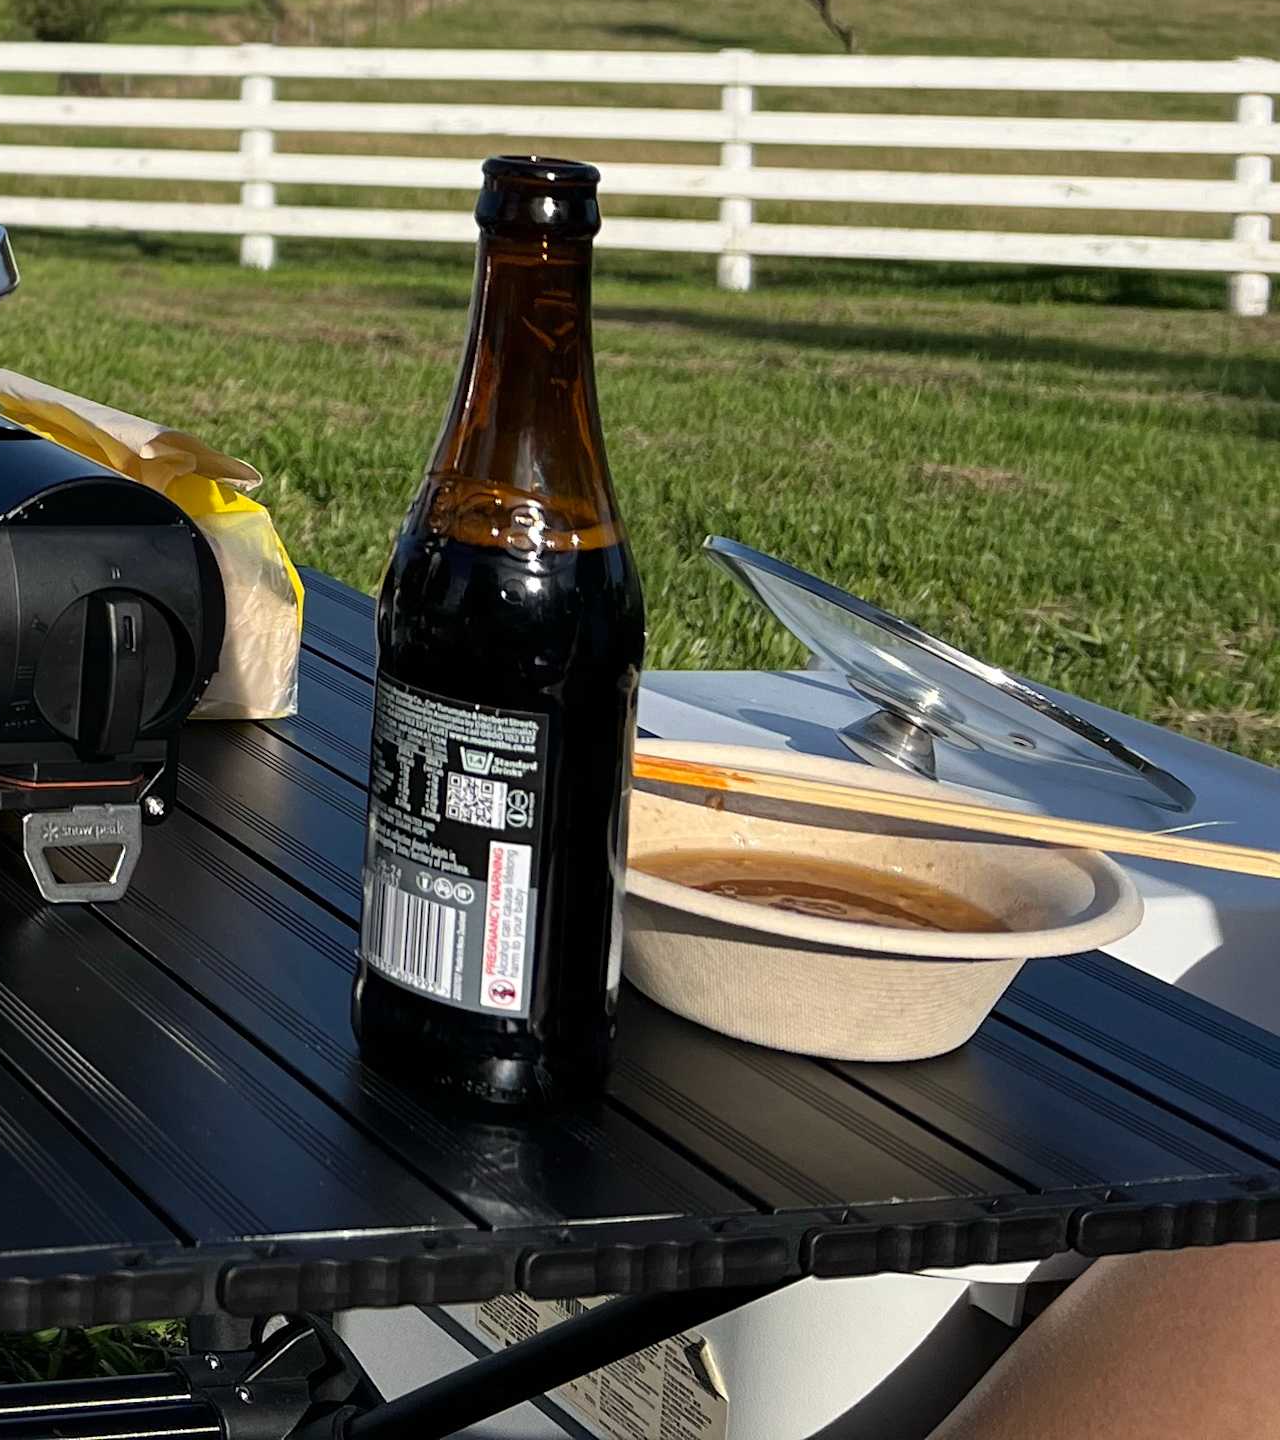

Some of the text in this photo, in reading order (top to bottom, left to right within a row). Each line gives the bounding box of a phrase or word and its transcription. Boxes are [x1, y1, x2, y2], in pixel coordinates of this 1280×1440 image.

[490, 765, 524, 778] Drinks
[493, 756, 538, 772] Standard
[61, 819, 125, 840] snow peak
[489, 847, 504, 902] WARNING
[503, 887, 514, 918] cause
[514, 888, 528, 914] baby
[501, 918, 512, 938] can
[512, 915, 526, 938] your
[485, 902, 500, 976] PREGNANCY
[498, 940, 510, 977] Alcohol
